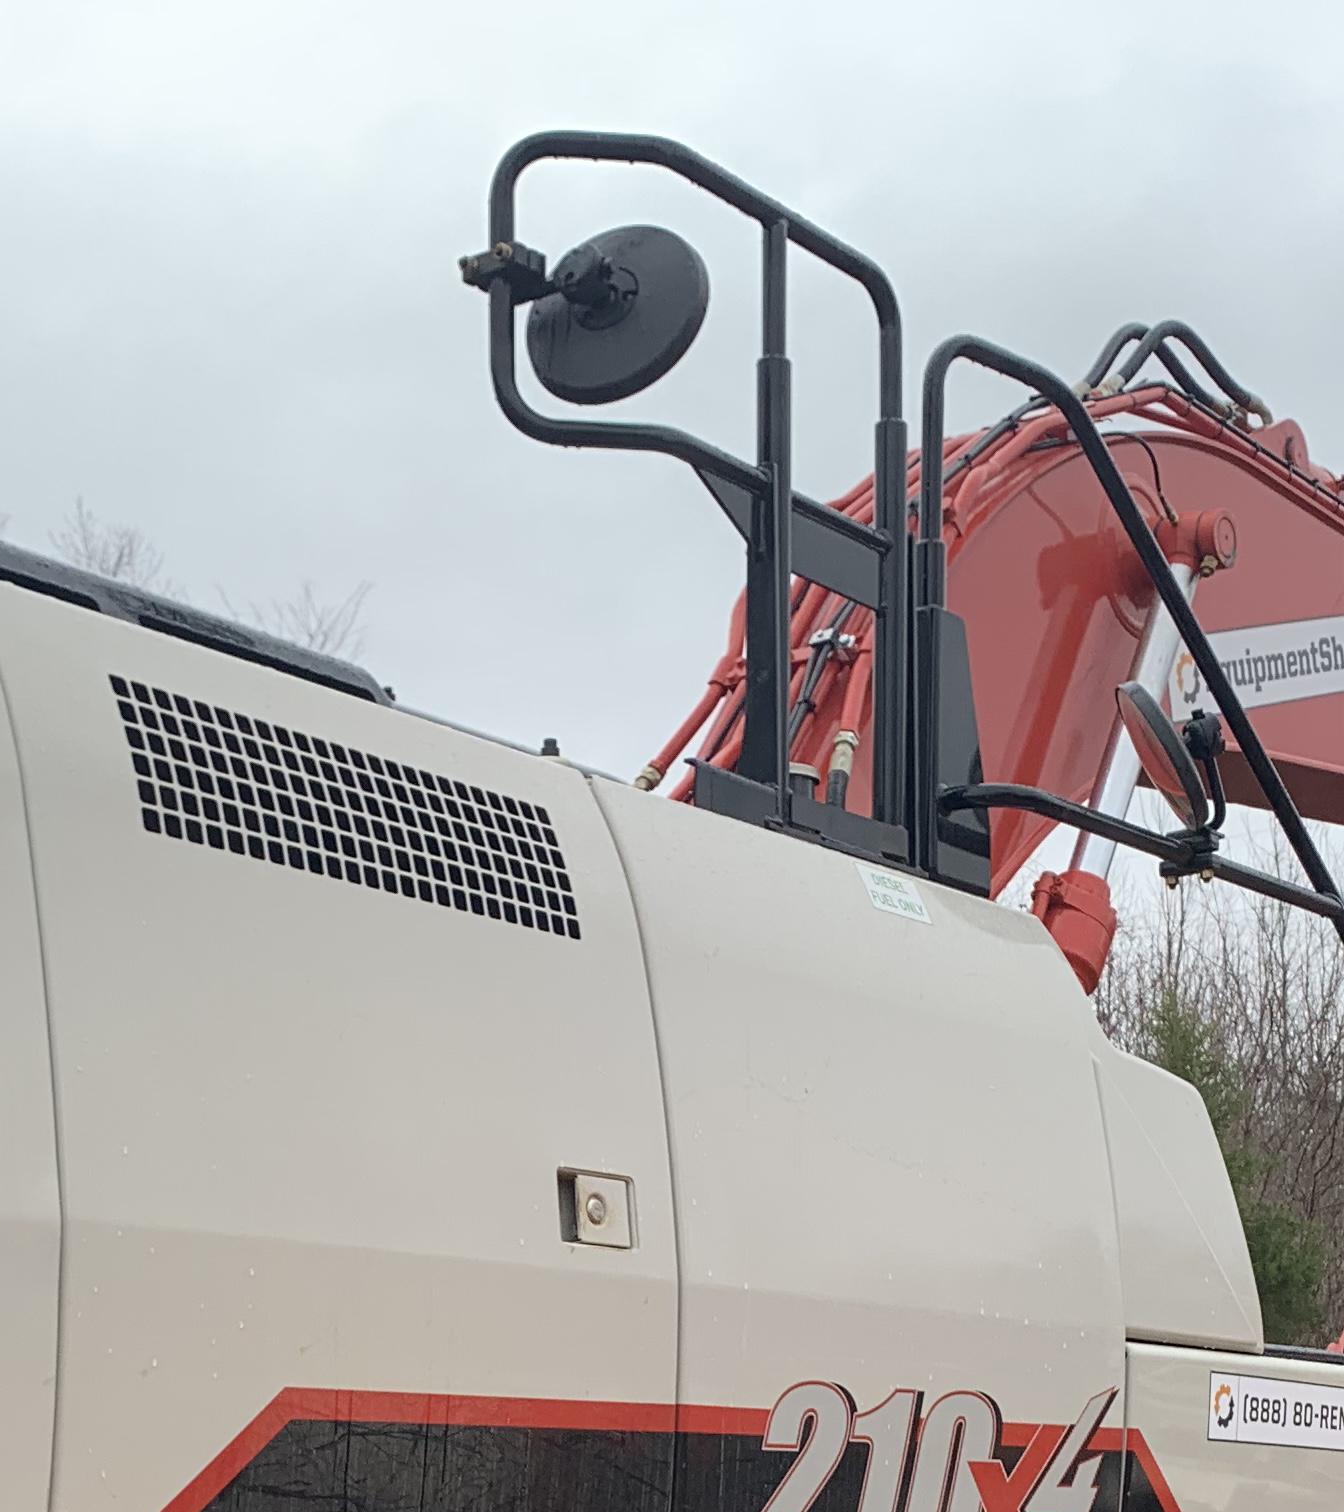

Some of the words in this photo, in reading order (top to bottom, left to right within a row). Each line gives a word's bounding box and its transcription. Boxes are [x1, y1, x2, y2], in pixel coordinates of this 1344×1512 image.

[871, 891, 898, 909] FUEL
[899, 899, 923, 915] ONLY
[1243, 1393, 1287, 1427] (888)
